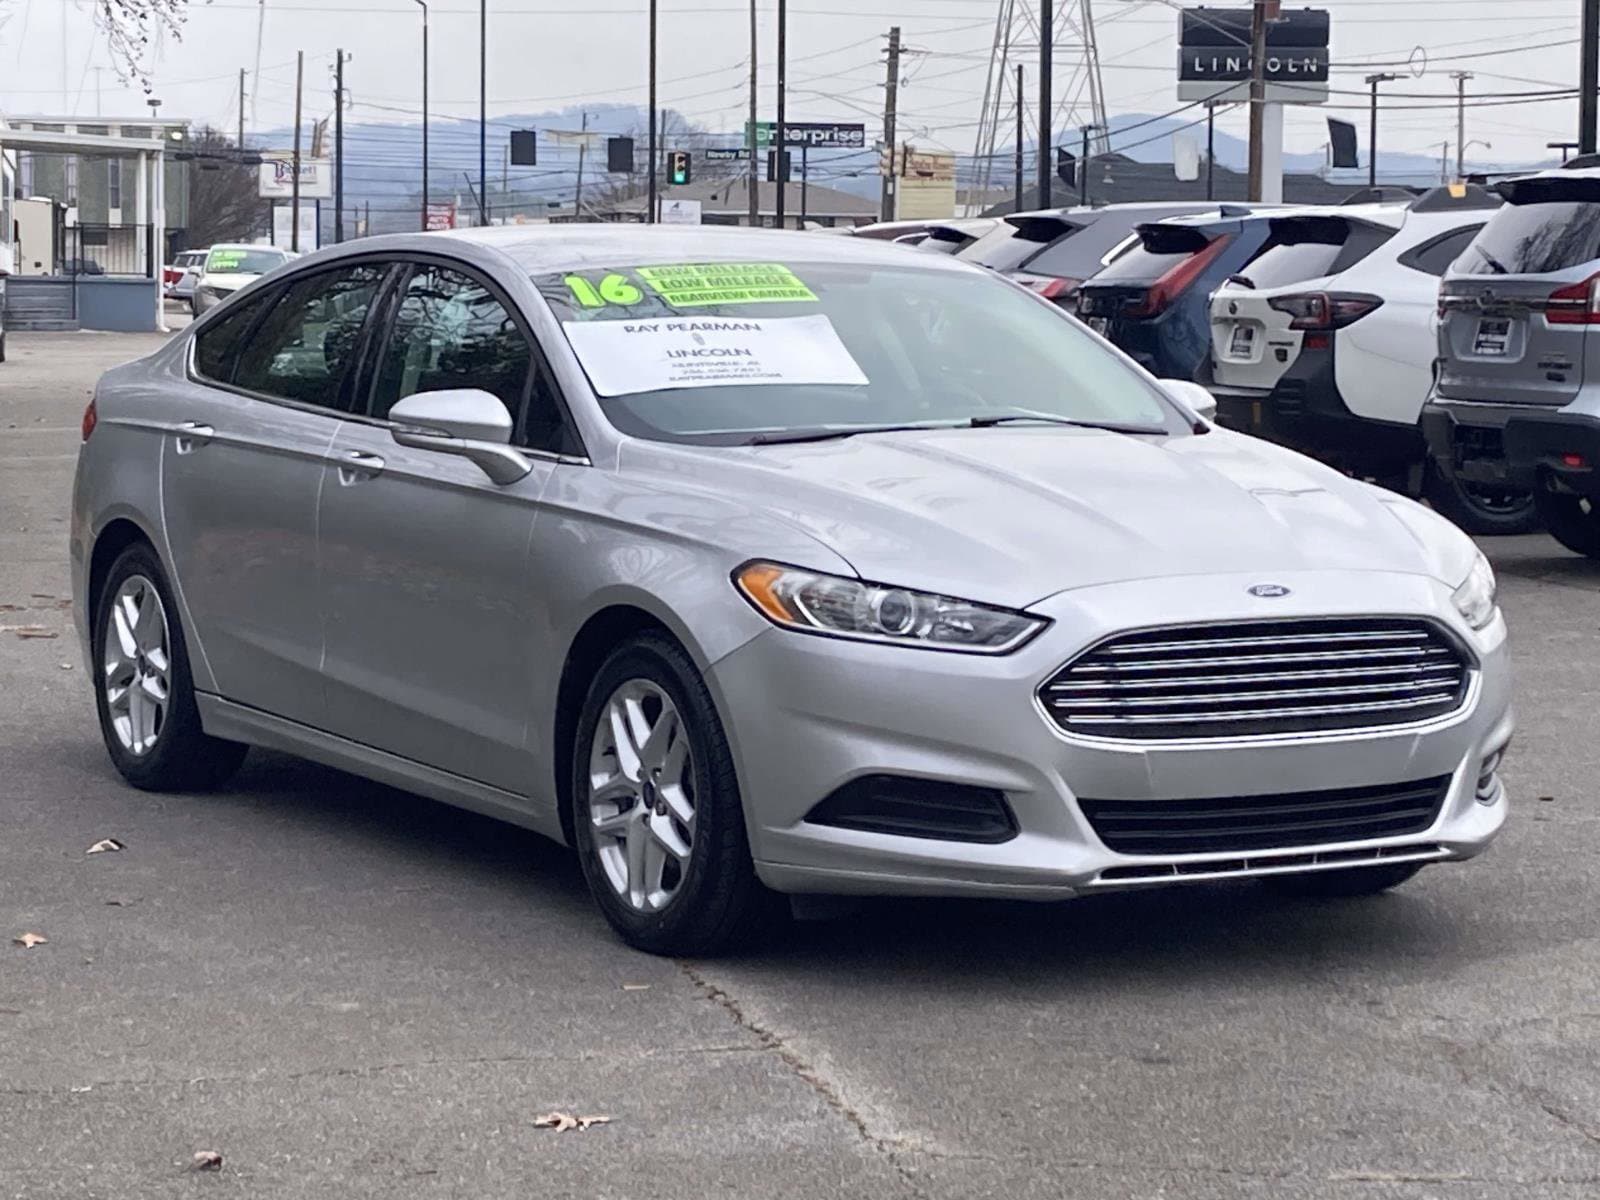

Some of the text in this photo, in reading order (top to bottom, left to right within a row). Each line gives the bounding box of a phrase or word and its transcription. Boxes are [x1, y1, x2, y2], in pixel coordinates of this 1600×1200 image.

[1194, 57, 1318, 73] LINOLN
[659, 276, 791, 290] LOW MILEAGE
[564, 274, 645, 308] 16
[669, 288, 811, 303] REARVIEW CAMERA
[623, 322, 762, 333] RAY PEARMAN
[666, 348, 752, 359] LINCOLN
